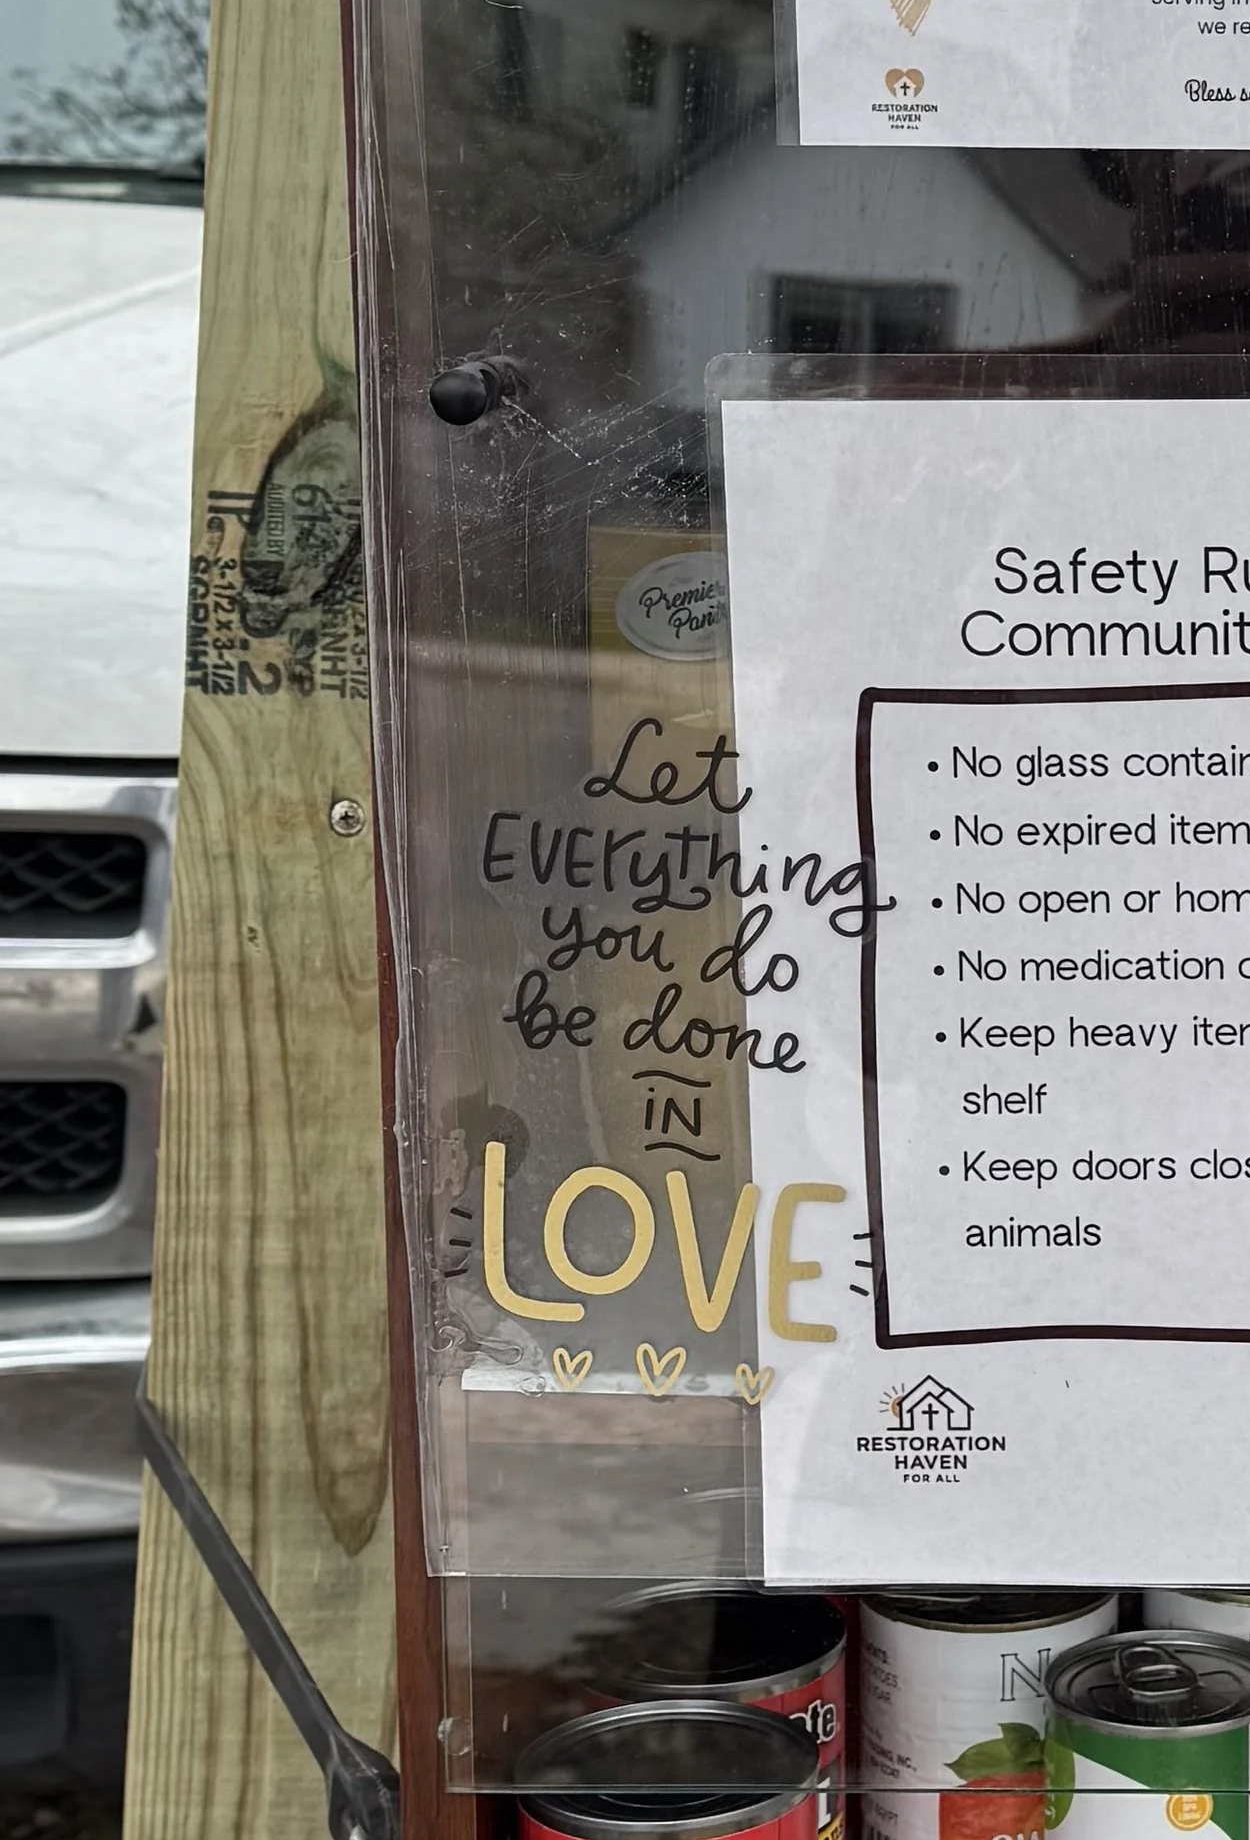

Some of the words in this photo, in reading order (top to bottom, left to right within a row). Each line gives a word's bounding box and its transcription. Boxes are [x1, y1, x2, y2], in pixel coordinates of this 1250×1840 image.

[1197, 21, 1226, 35] we
[871, 103, 938, 113] RESTORATION
[1184, 78, 1236, 102] Bless
[888, 113, 922, 123] HAVEN
[993, 545, 1179, 606] Safety
[584, 717, 752, 814] Let
[952, 746, 1002, 779] No
[1016, 745, 1109, 787] glass
[954, 815, 1004, 847] No
[1016, 813, 1157, 854] expired
[956, 883, 1006, 915] No
[1018, 890, 1111, 922] open
[1122, 889, 1161, 913] or
[542, 903, 674, 973] you
[700, 903, 800, 996] do
[957, 951, 1007, 983] No
[1020, 948, 1225, 981] medication
[504, 969, 597, 1050] be
[623, 983, 808, 1074] done
[960, 1017, 1055, 1056] Keep
[1068, 1015, 1178, 1054] heavy
[961, 1083, 1048, 1116] shelf
[962, 1150, 1058, 1189] Keep
[1071, 1149, 1177, 1181] doors
[483, 1140, 848, 1342] LOVE
[964, 1217, 1102, 1249] animals
[857, 1435, 1006, 1452] RESTORATION
[894, 1454, 968, 1470] HAVEN
[903, 1473, 930, 1483] FOR
[936, 1473, 960, 1483] ALL
